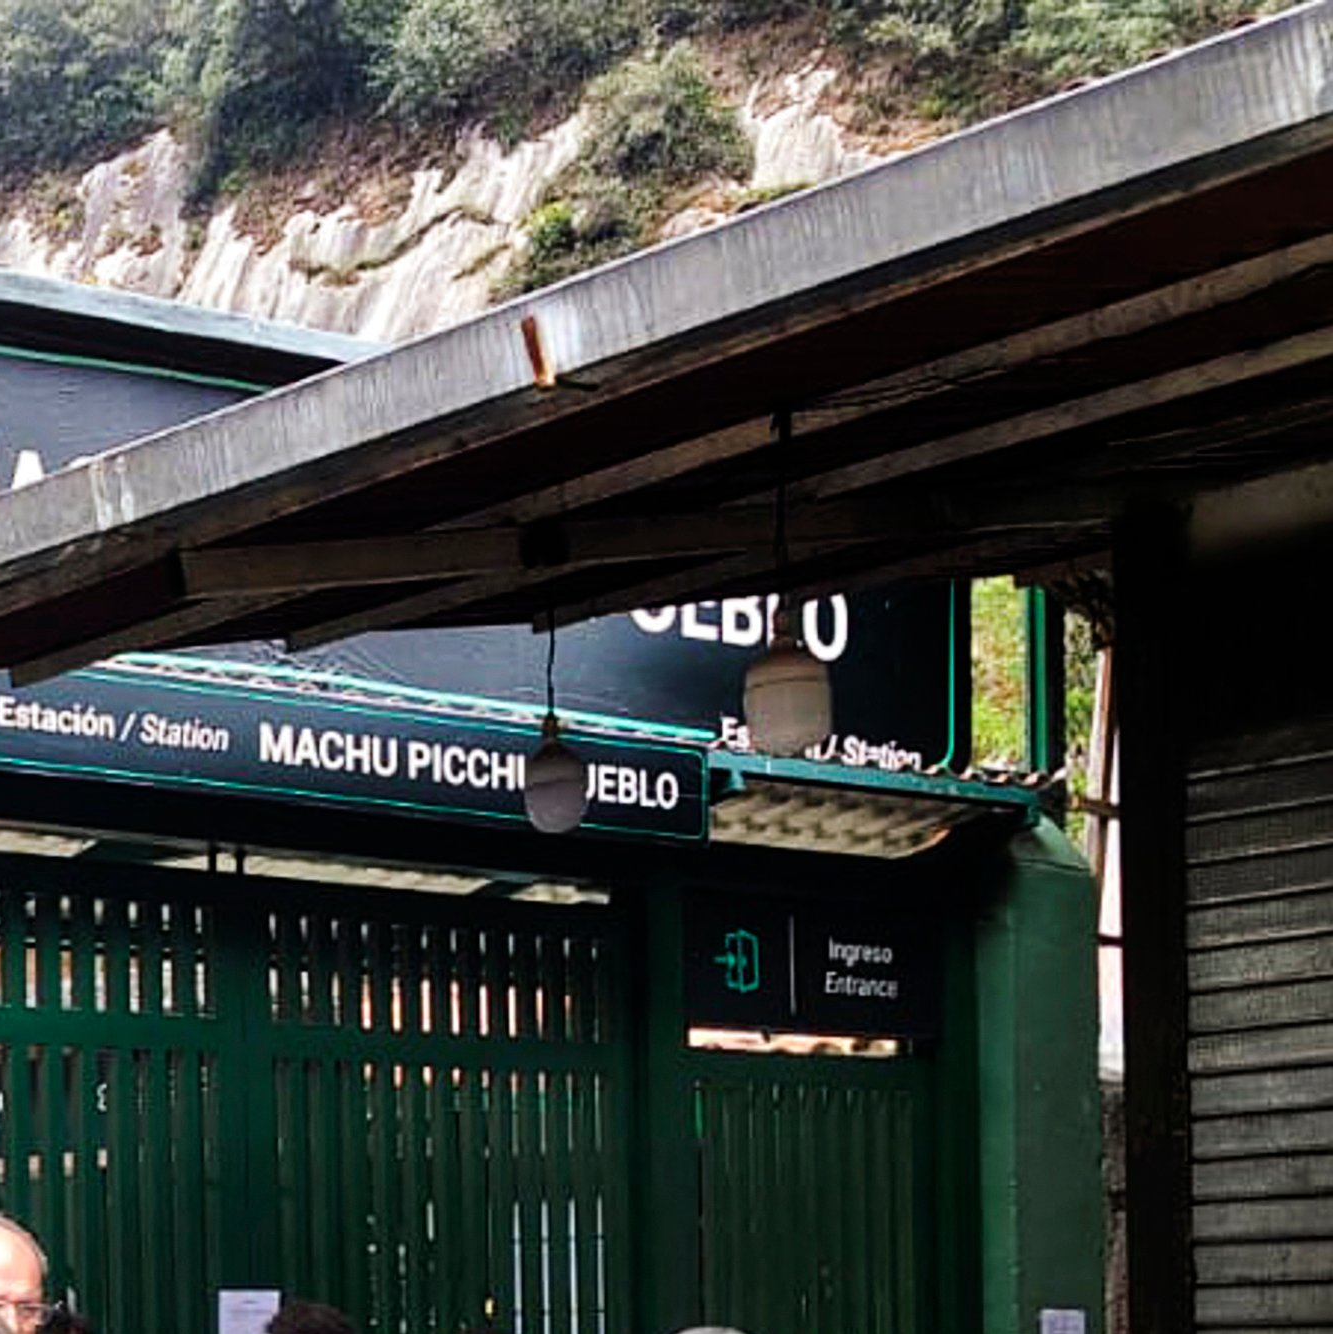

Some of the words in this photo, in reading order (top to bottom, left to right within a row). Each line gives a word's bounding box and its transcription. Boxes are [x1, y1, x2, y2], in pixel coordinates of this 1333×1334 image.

[119, 712, 136, 743] /
[139, 713, 230, 752] Station
[258, 722, 399, 777] MACHU
[828, 936, 894, 967] Ingreso
[825, 971, 899, 998] Entrance
